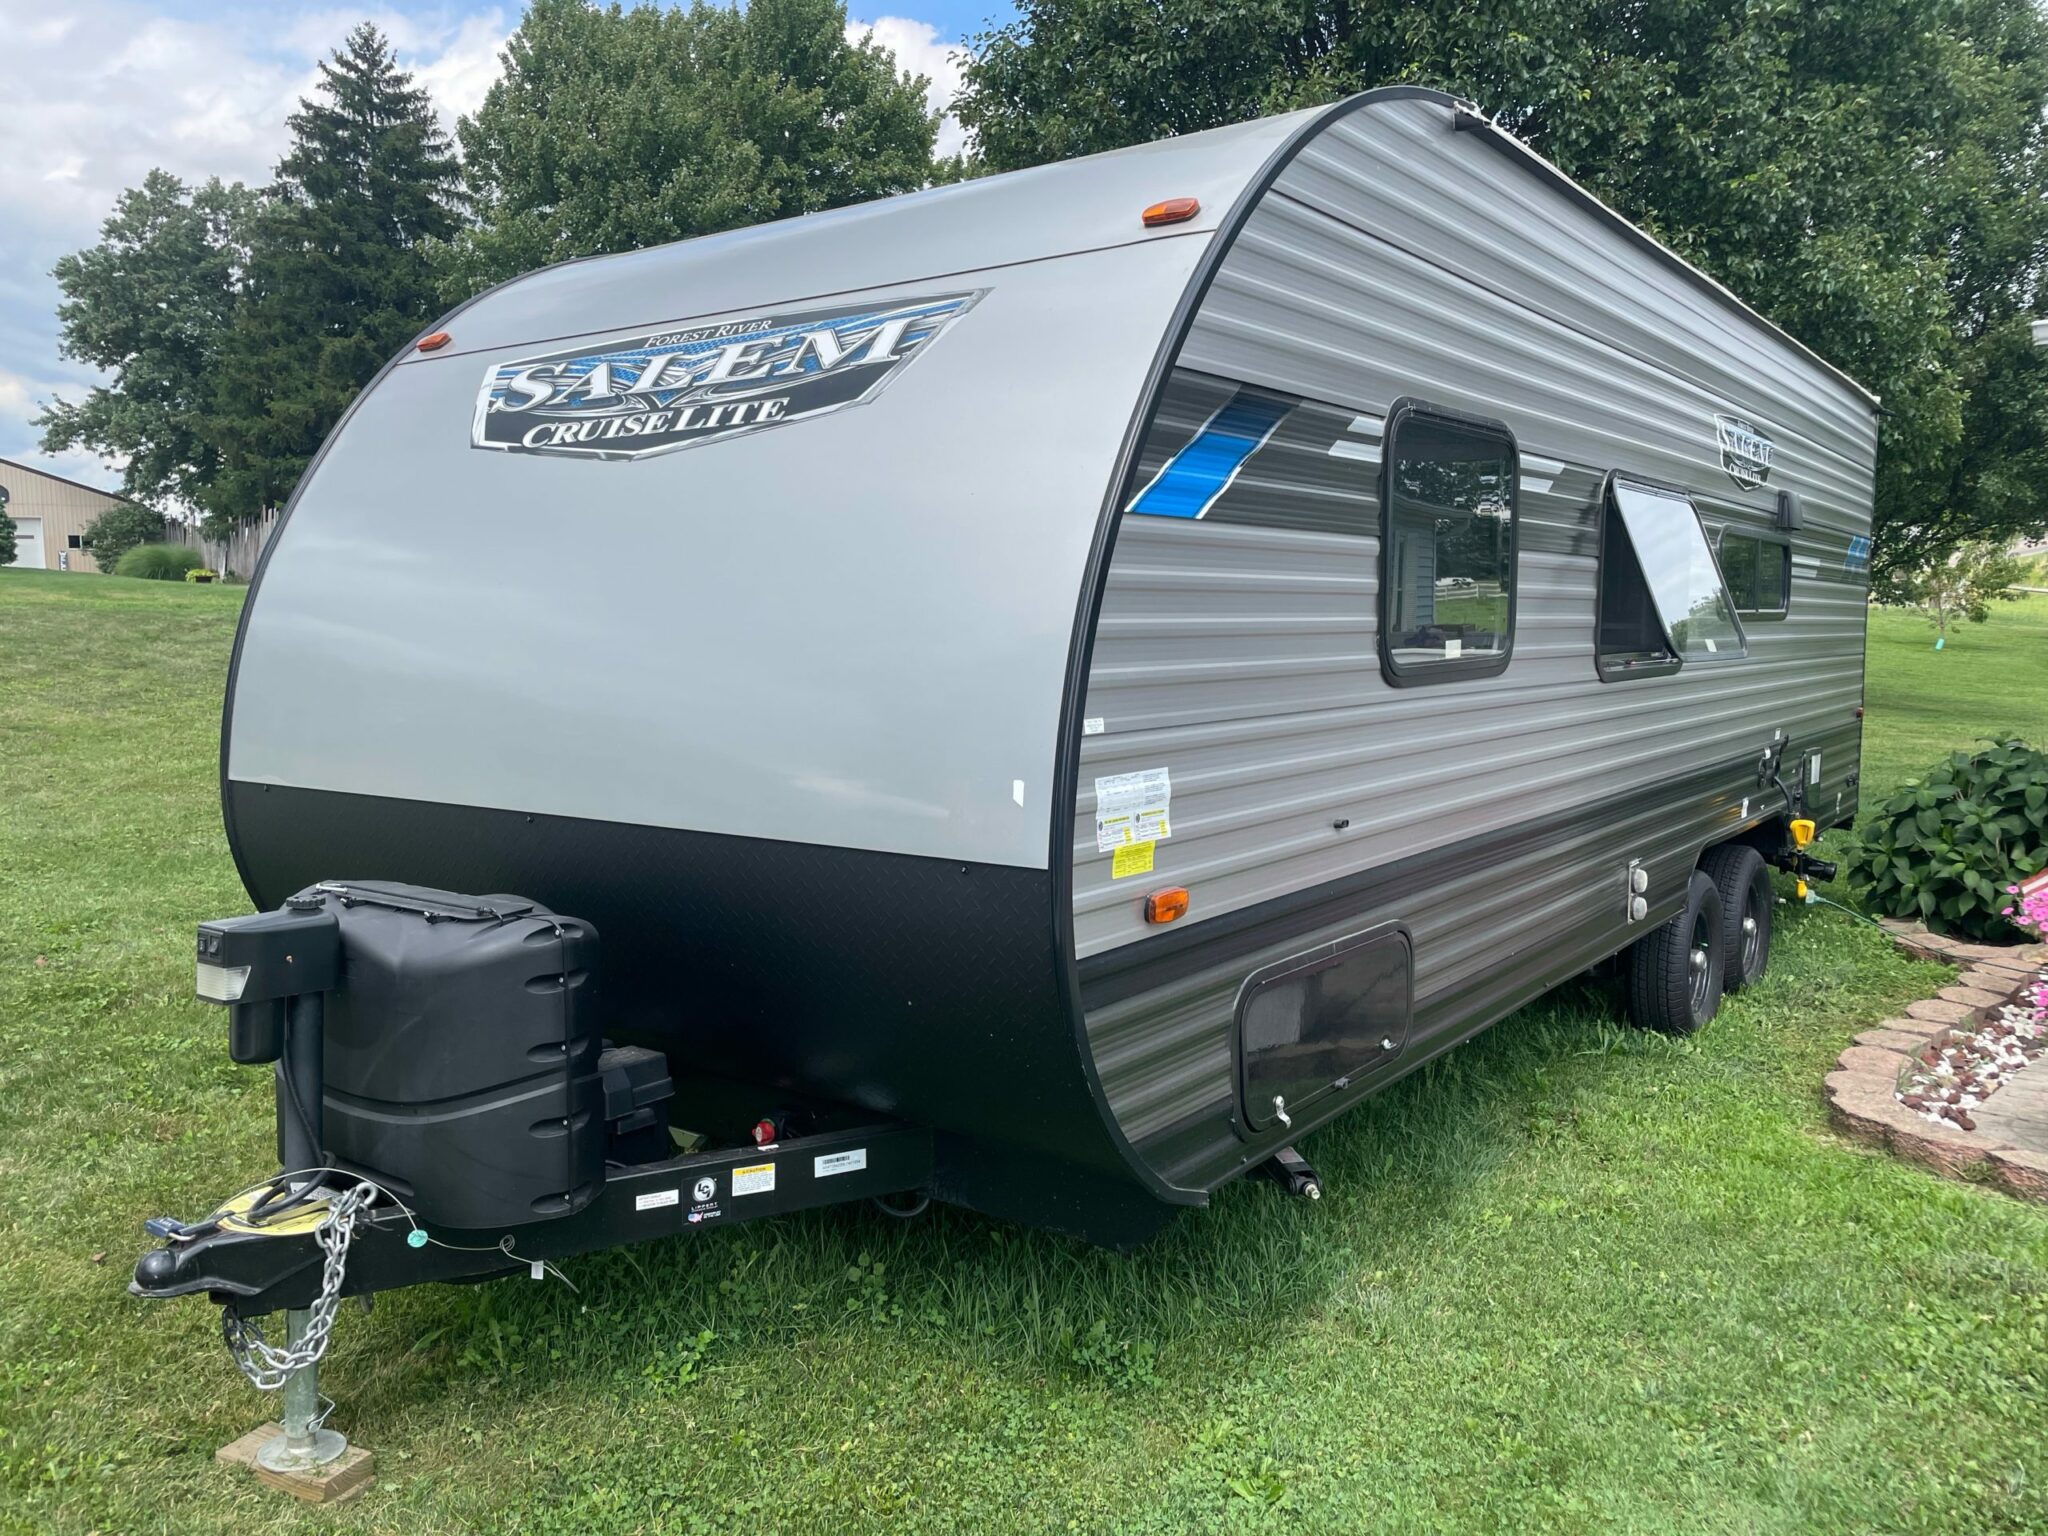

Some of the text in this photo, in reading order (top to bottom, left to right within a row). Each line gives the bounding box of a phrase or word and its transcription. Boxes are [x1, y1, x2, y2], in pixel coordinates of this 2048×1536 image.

[490, 315, 927, 414] SALEM
[643, 320, 773, 349] FOREST RIVER
